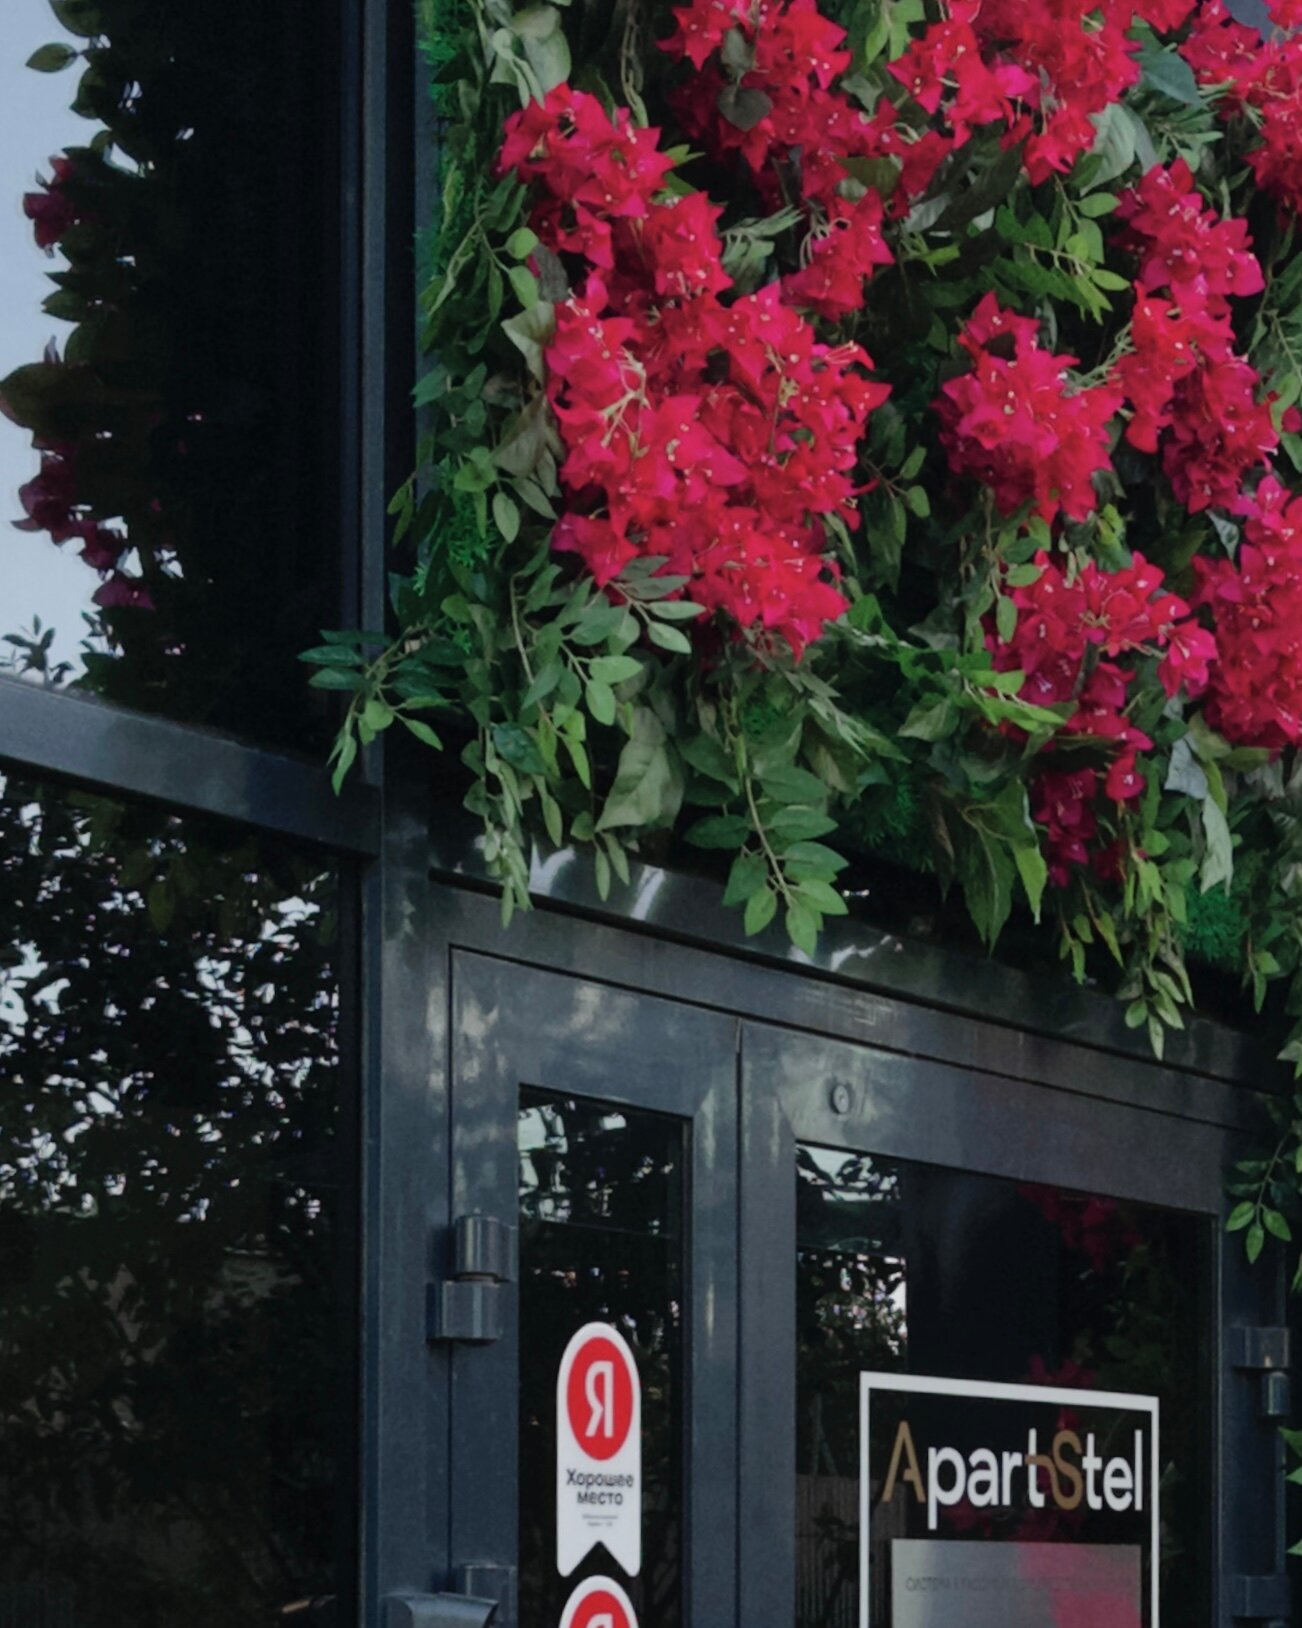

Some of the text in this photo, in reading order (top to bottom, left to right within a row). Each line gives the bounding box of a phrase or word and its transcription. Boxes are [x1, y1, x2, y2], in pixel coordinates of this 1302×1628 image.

[584, 1360, 614, 1438] Я
[566, 1468, 634, 1490] Хорошее
[577, 1490, 623, 1506] место
[882, 1420, 1143, 1530] ApartStel
